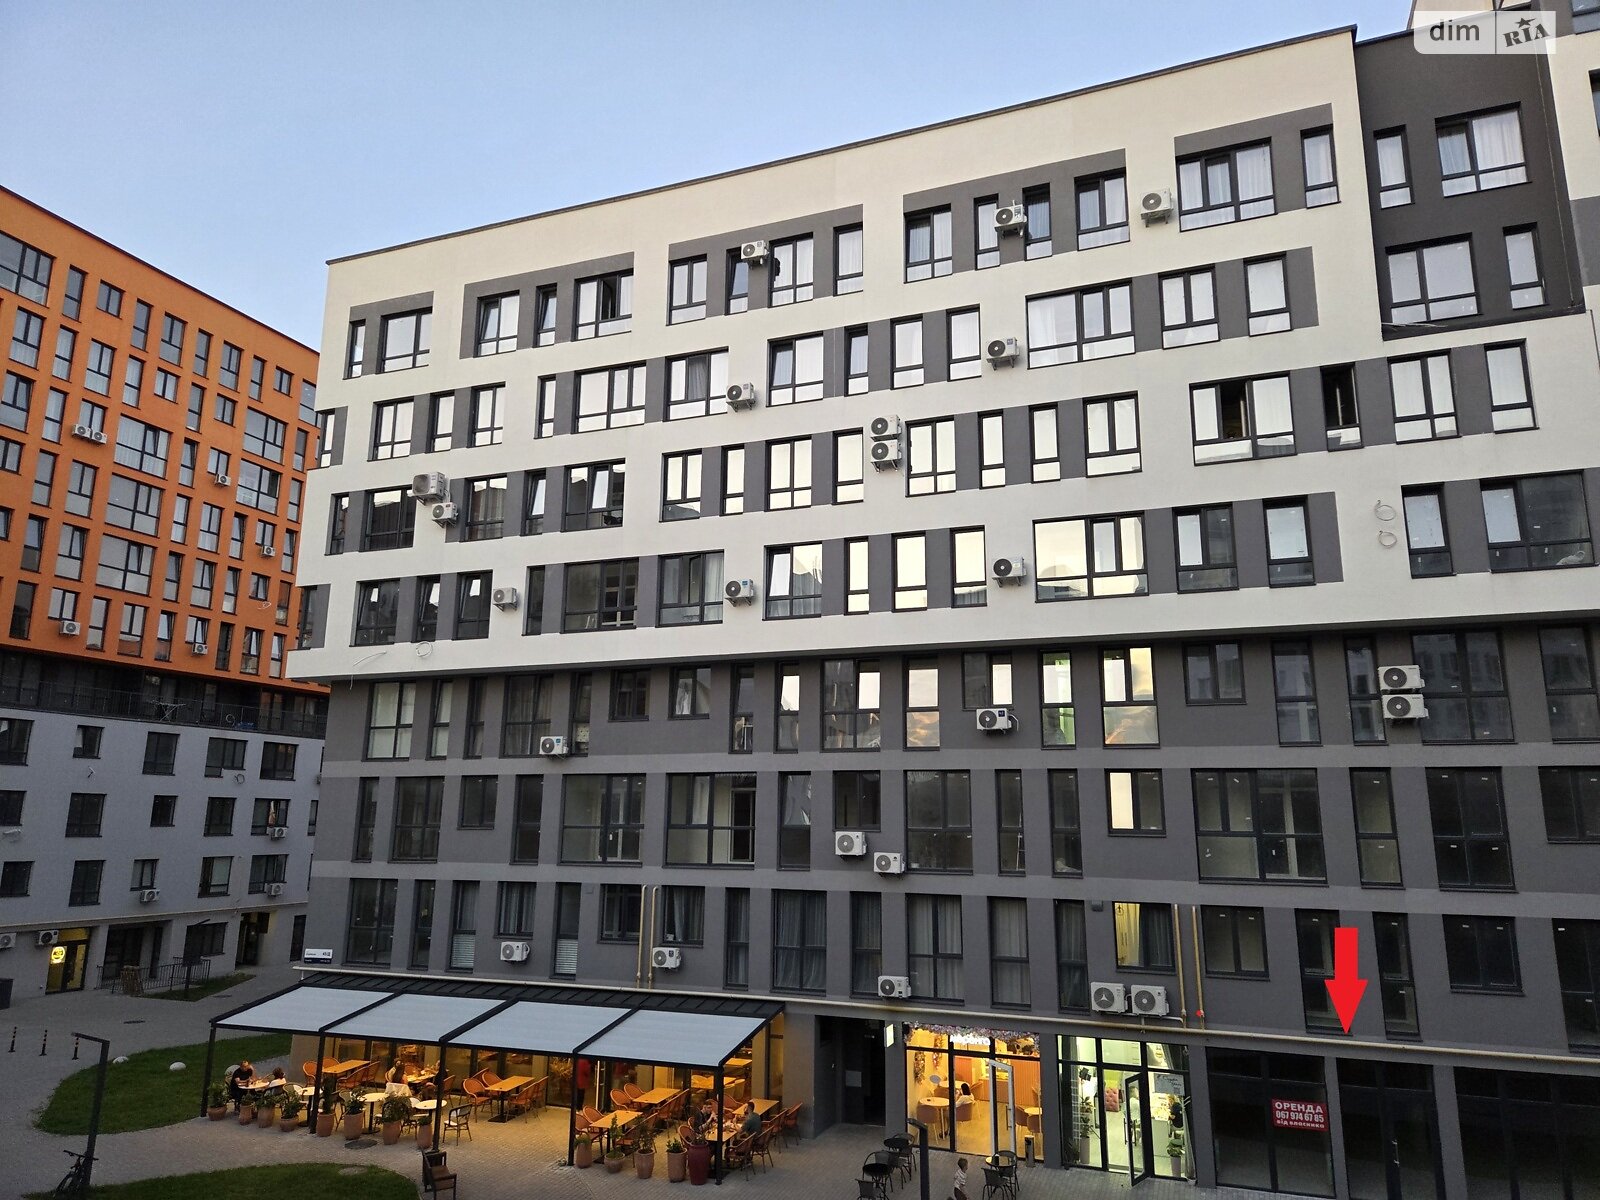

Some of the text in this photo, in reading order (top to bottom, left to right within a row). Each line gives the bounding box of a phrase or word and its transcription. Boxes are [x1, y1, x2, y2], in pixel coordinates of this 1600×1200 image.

[1275, 1101, 1324, 1114] ОРЕНДА
[1275, 1110, 1324, 1123] 067 974 67 85
